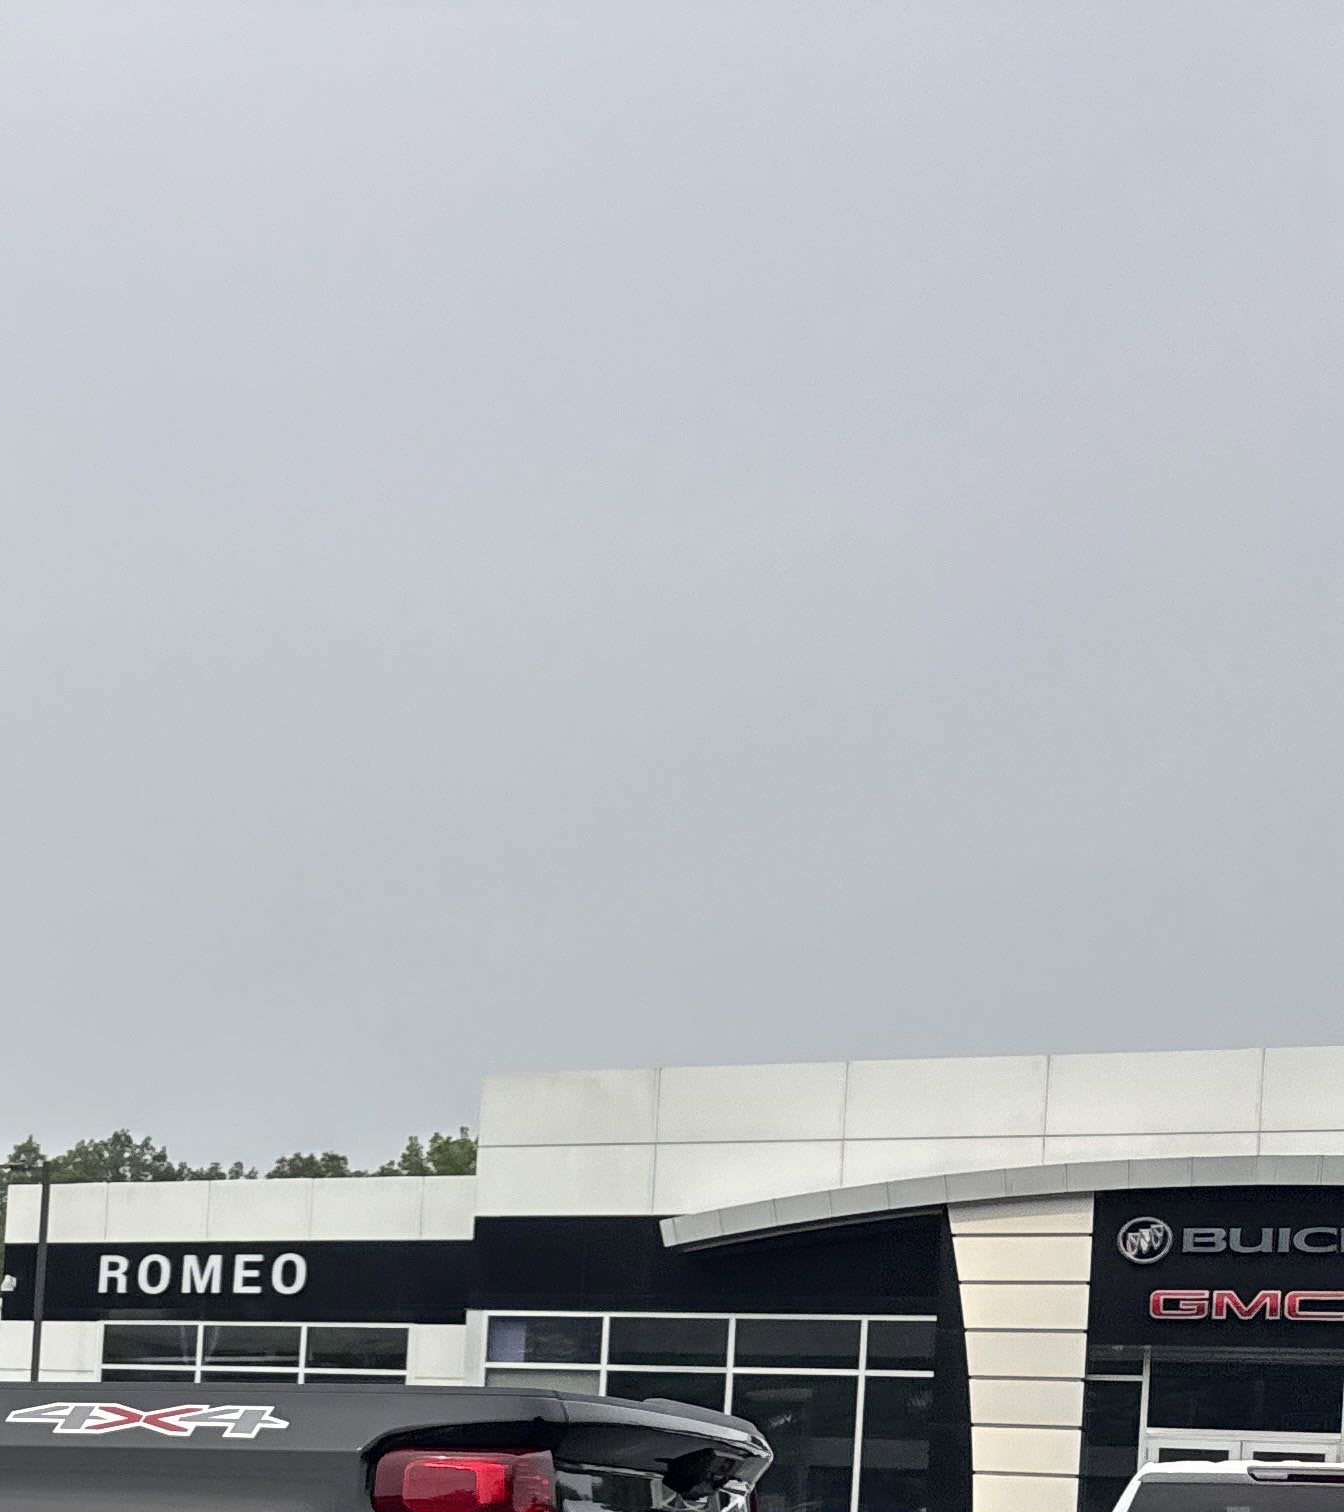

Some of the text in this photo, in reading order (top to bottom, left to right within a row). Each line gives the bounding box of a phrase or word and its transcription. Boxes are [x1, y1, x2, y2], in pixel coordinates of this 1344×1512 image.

[1182, 1227, 1344, 1254] BUIC
[98, 1253, 308, 1295] ROMEO
[1149, 1289, 1344, 1321] GMC
